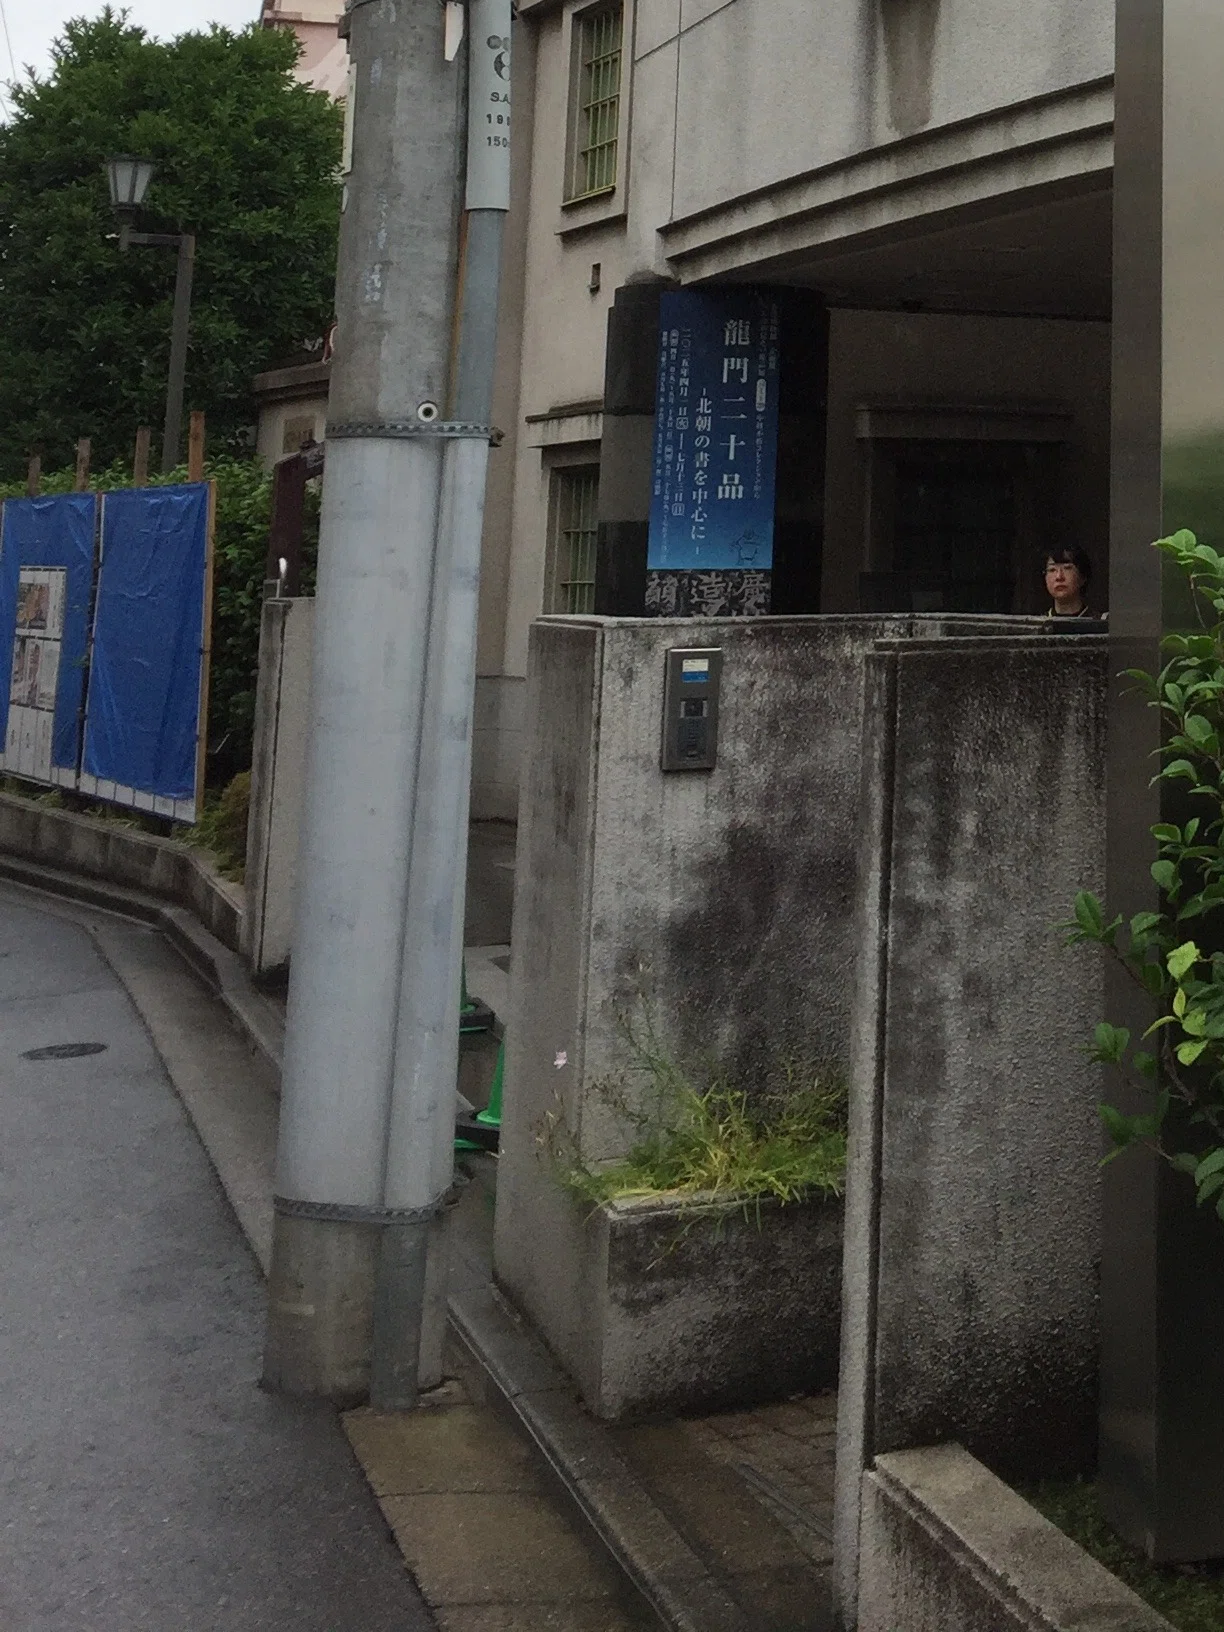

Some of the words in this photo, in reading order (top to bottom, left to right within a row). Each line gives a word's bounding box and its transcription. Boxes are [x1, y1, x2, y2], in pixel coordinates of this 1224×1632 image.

[717, 319, 750, 500] 龍門二十品
